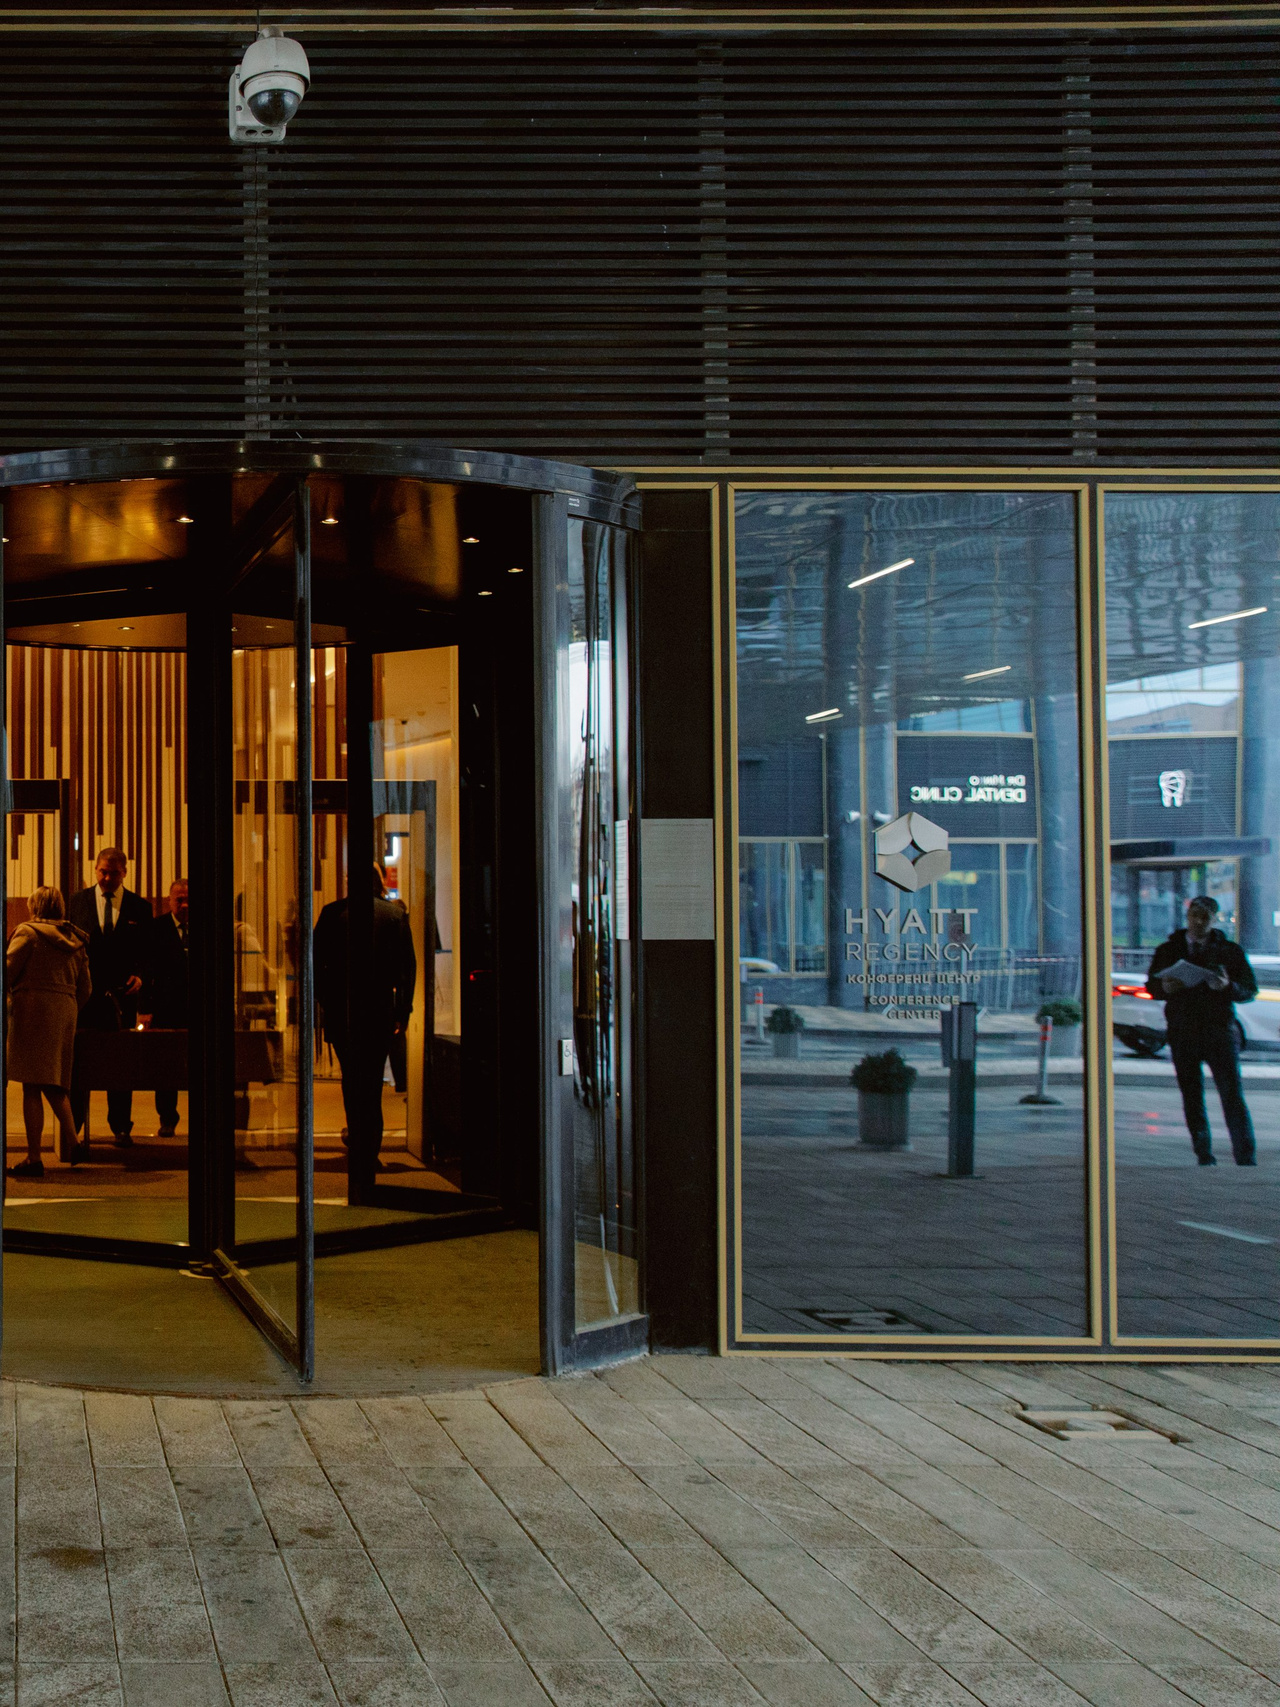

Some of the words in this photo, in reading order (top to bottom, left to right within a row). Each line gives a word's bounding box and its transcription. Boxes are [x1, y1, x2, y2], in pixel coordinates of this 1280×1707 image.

[845, 908, 978, 934] HYATT
[846, 942, 978, 961] REGENCY
[847, 974, 932, 985] КОНФЕРЕНЦ
[936, 974, 981, 986] ЦЕНТР
[868, 995, 960, 1006] CONFERENCE
[886, 1009, 941, 1020] CENTER
